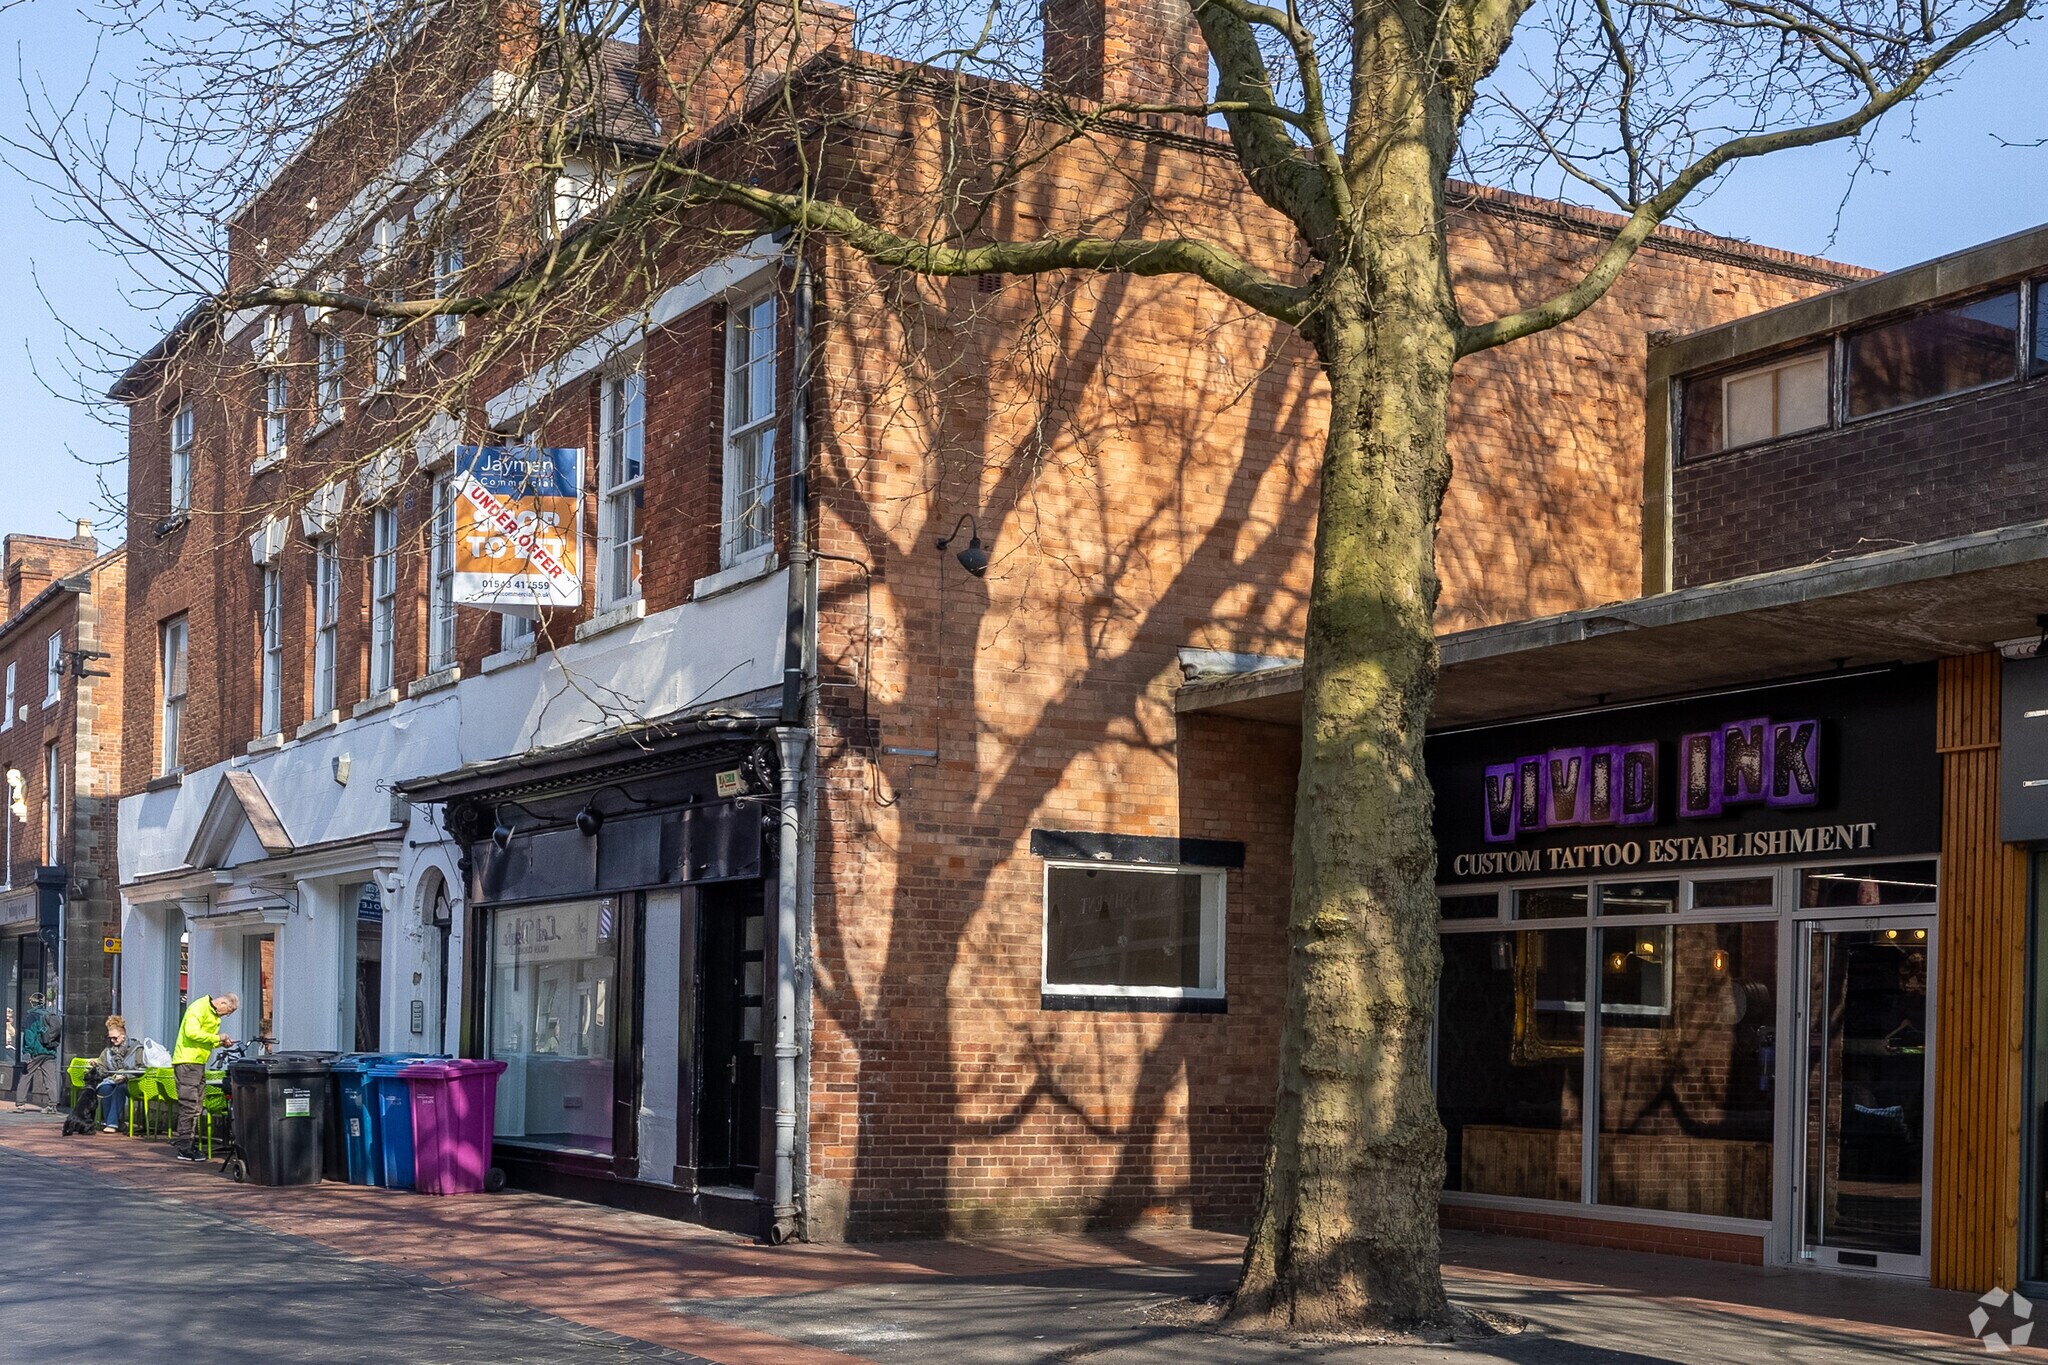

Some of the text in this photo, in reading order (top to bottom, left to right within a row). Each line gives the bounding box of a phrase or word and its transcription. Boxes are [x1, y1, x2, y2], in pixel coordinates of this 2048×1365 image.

[481, 477, 554, 488] Commcial
[466, 536, 566, 560] TO LT
[471, 486, 563, 579] UNDER OFFER
[514, 581, 550, 590] 41559
[1485, 723, 1818, 838] VIVID INK
[1453, 822, 1878, 878] CUSTOM TATTOO ESTABLISHMENT
